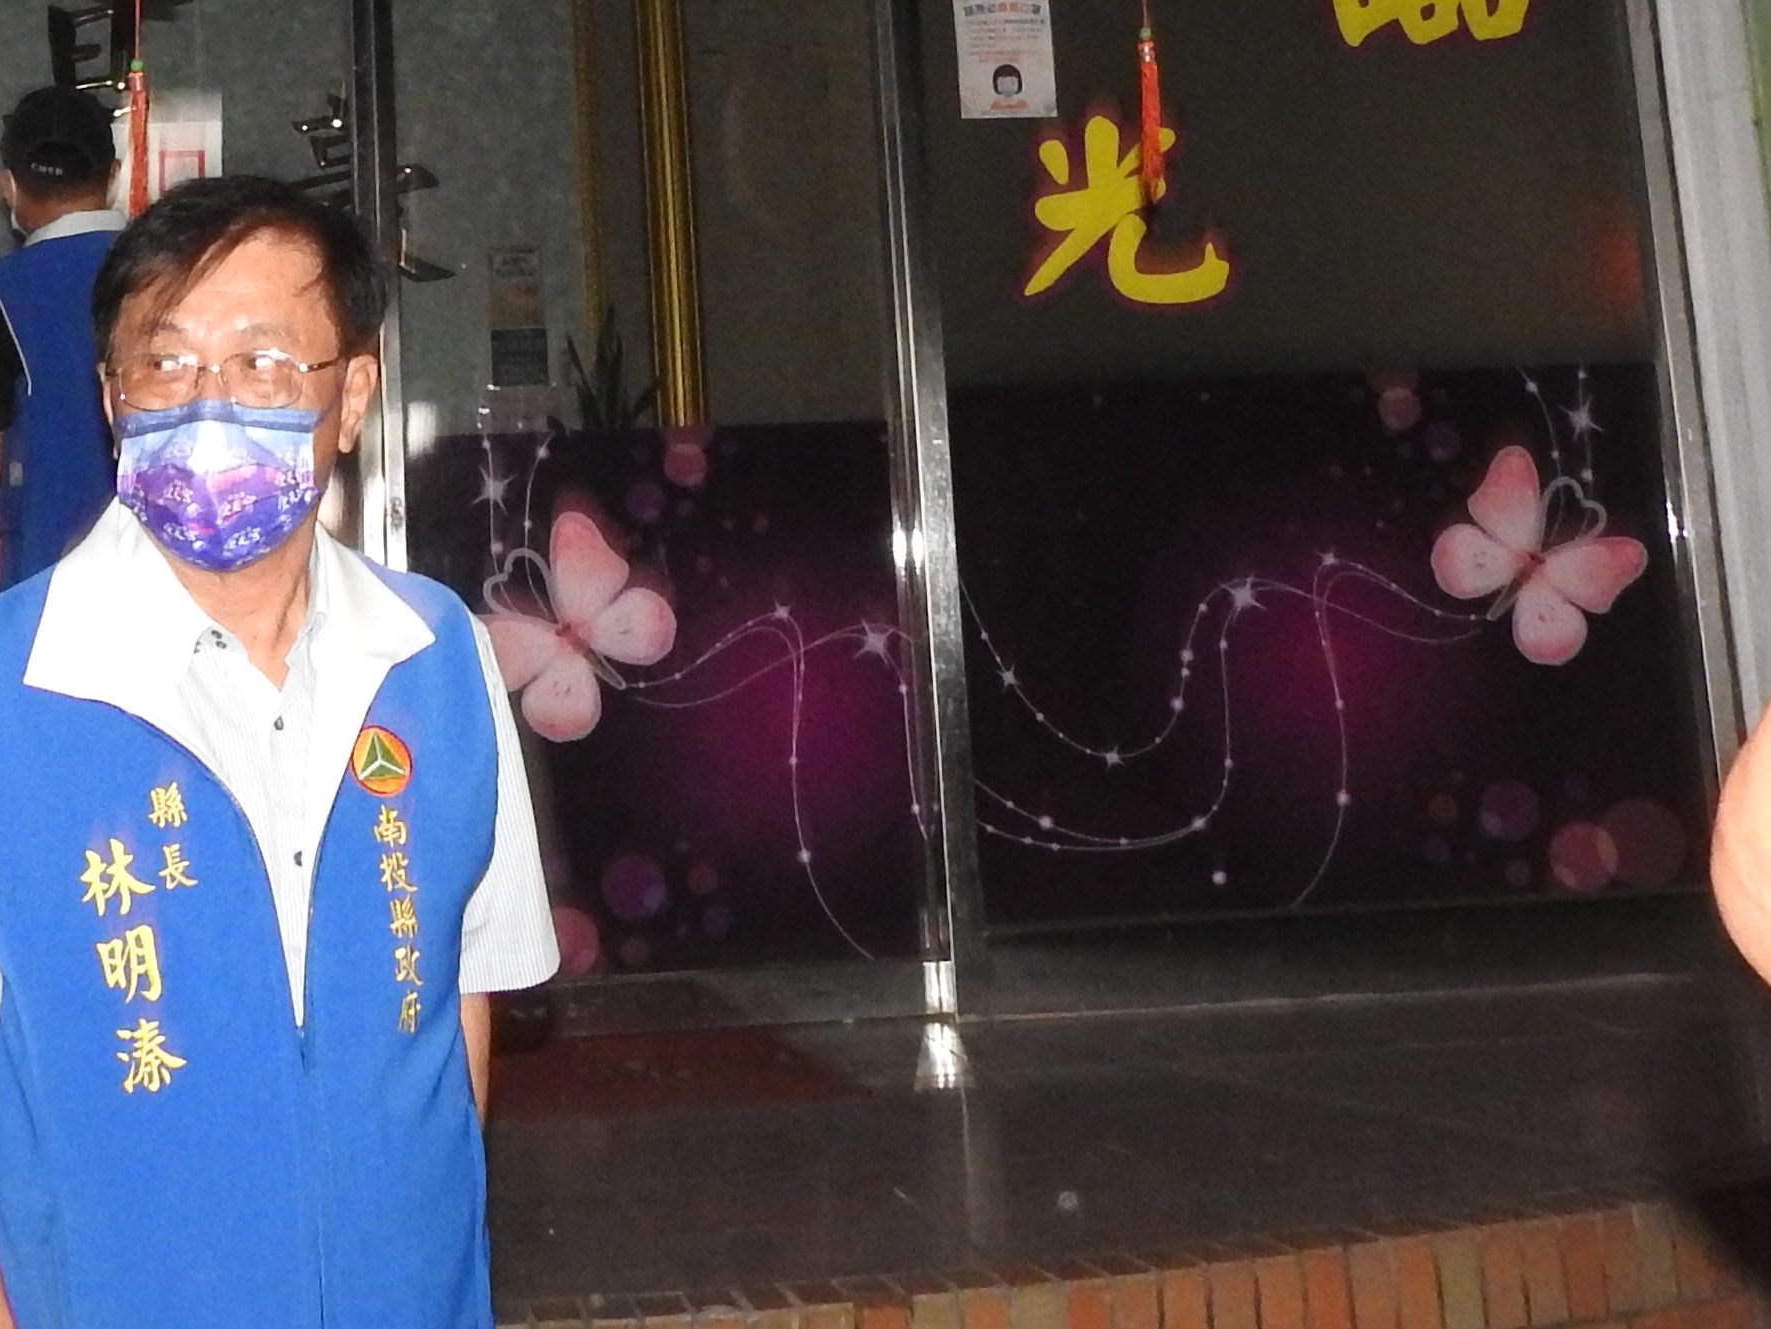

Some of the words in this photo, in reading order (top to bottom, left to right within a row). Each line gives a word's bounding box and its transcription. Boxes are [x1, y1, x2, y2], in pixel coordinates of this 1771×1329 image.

[1023, 115, 1230, 304] 光
[148, 781, 199, 891] 縣長
[373, 804, 423, 1034] 南投縣政府
[79, 838, 188, 1094] 林明溱
